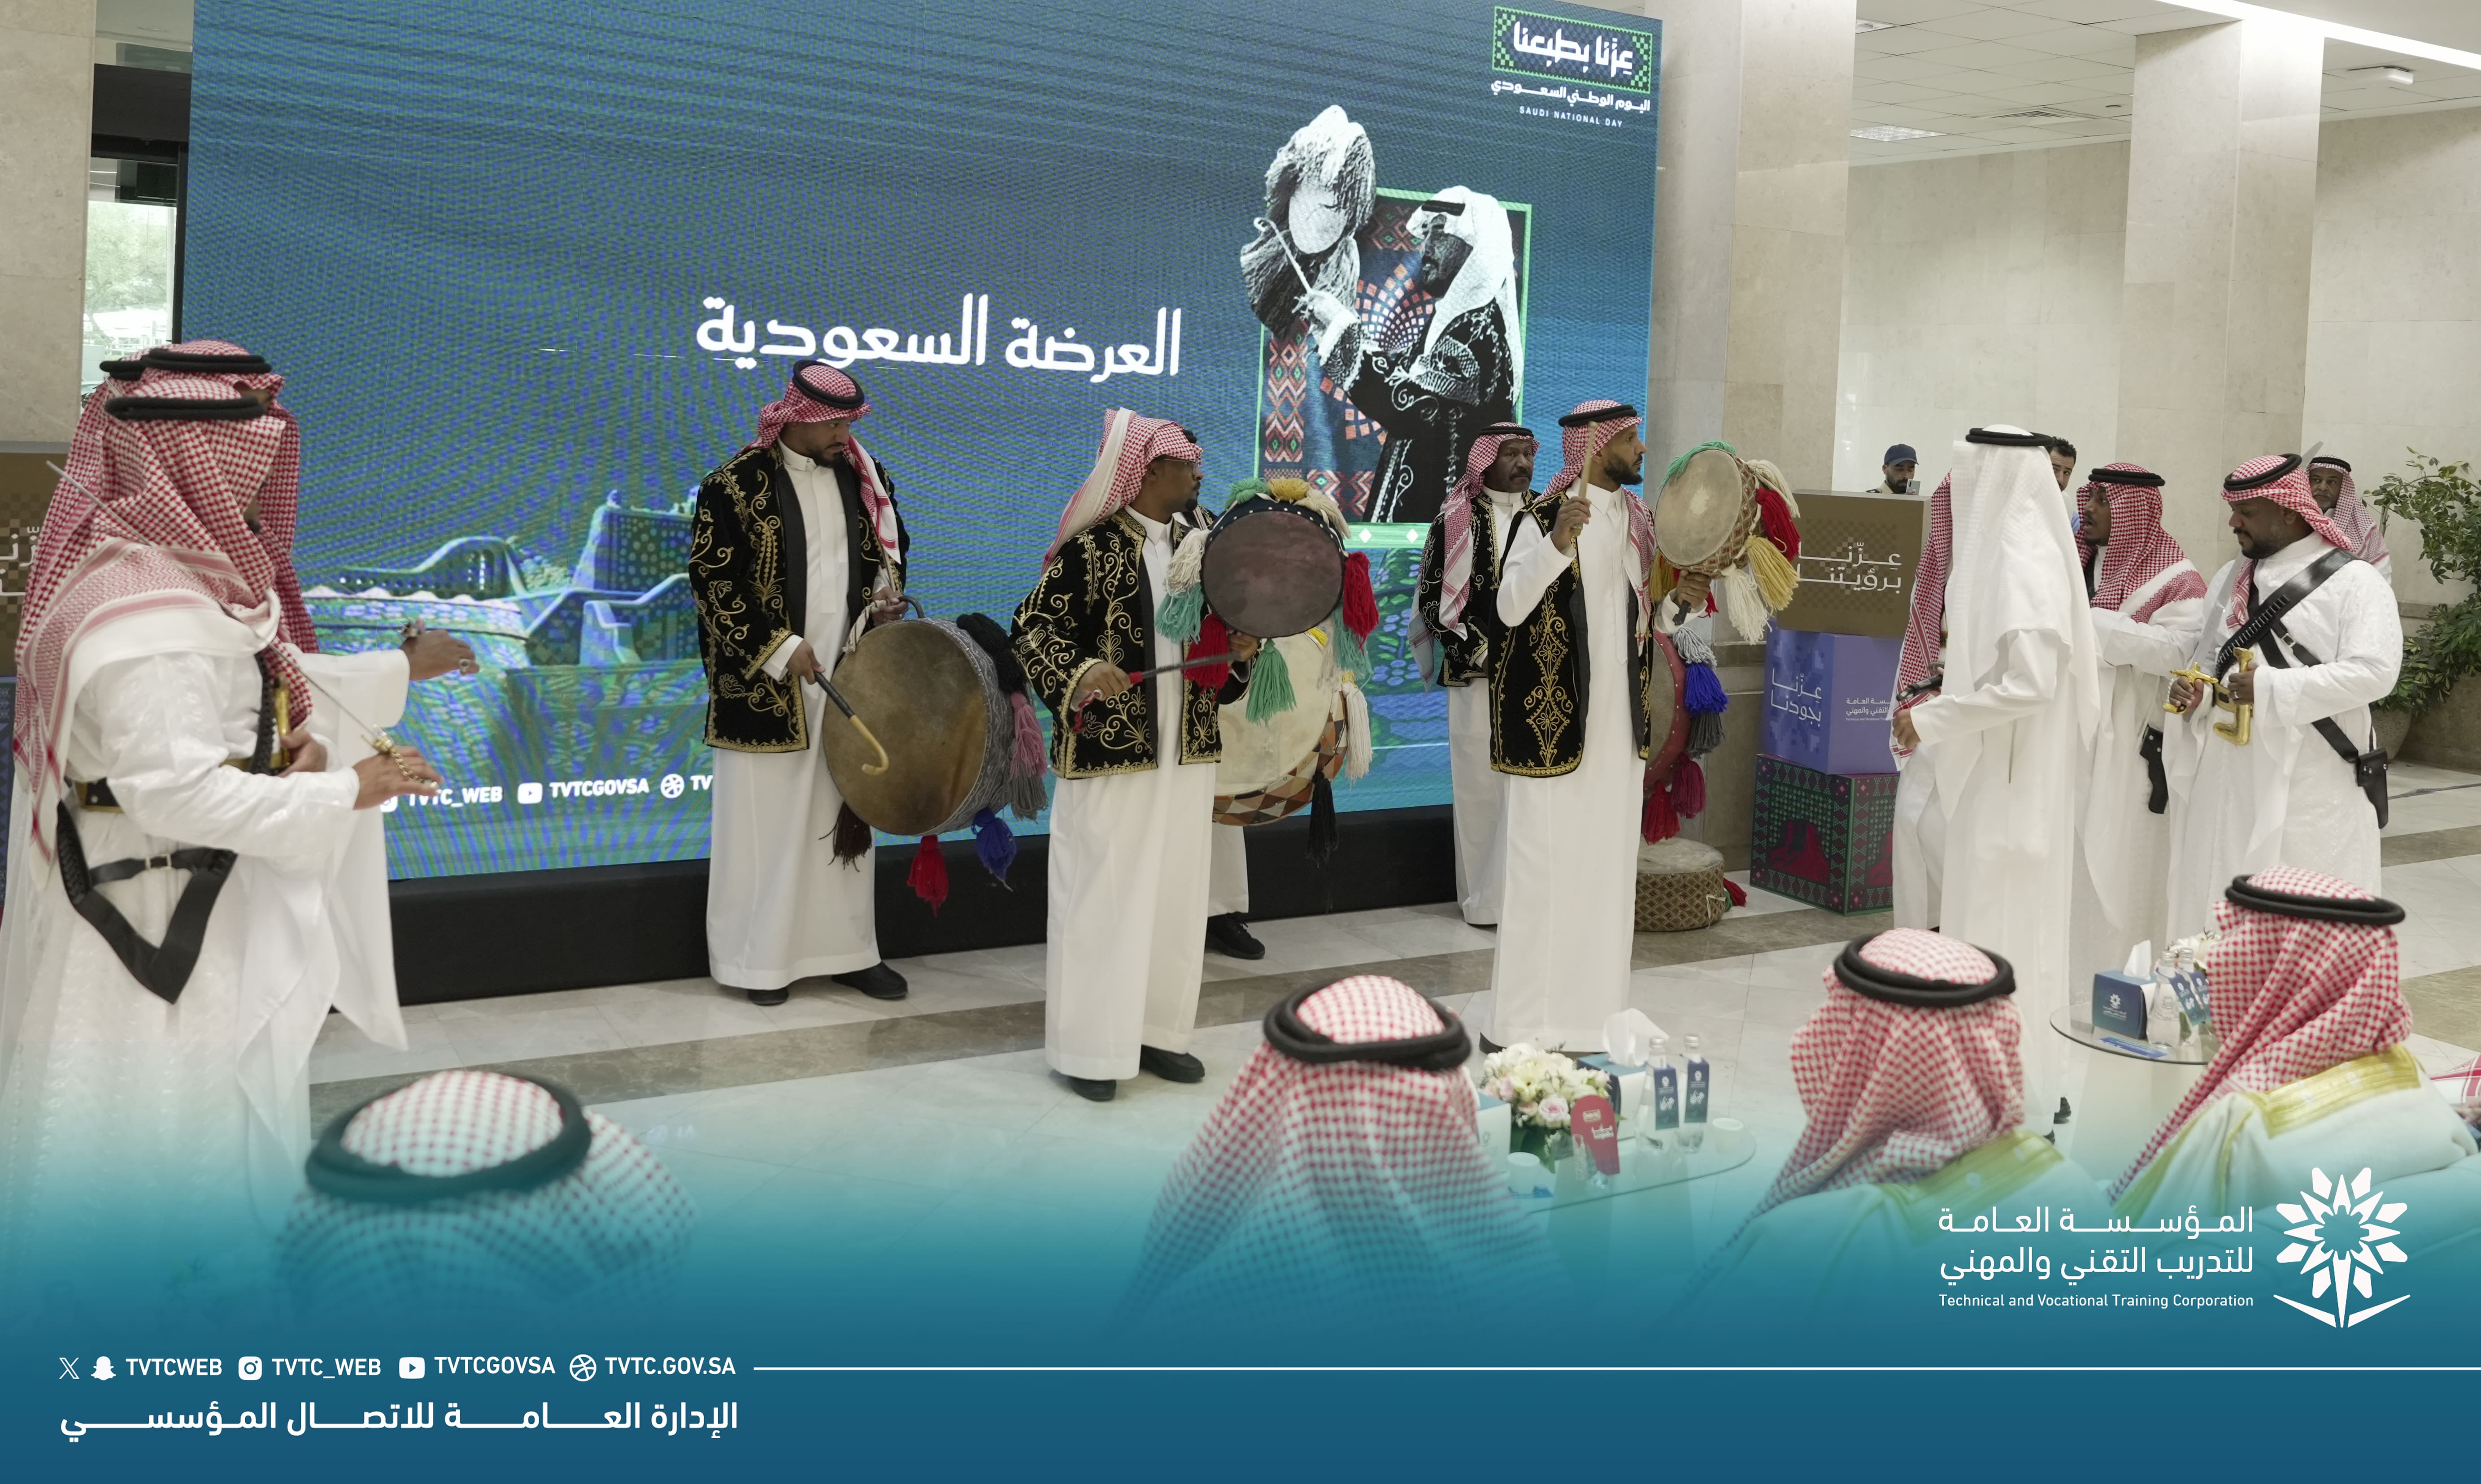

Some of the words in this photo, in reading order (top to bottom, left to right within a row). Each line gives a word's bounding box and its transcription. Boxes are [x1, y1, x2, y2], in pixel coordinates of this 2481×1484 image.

[1514, 21, 1589, 73] بطبعنا
[1491, 80, 1567, 98] السعودي
[1567, 89, 1614, 107] الوطني
[1519, 106, 1549, 117] SAUDI
[1554, 111, 1600, 125] NATIONAL
[1605, 118, 1623, 127] DAY
[1615, 100, 1651, 113] اليوم
[696, 293, 988, 369] السعودية
[1005, 307, 1181, 383] العرضة
[1797, 563, 1902, 594] برؤيتنا
[1771, 689, 1821, 727] بجودنا
[1846, 706, 1869, 716] والمهني
[1870, 706, 1888, 716] التقني
[549, 777, 649, 798] TVTCGOVSA
